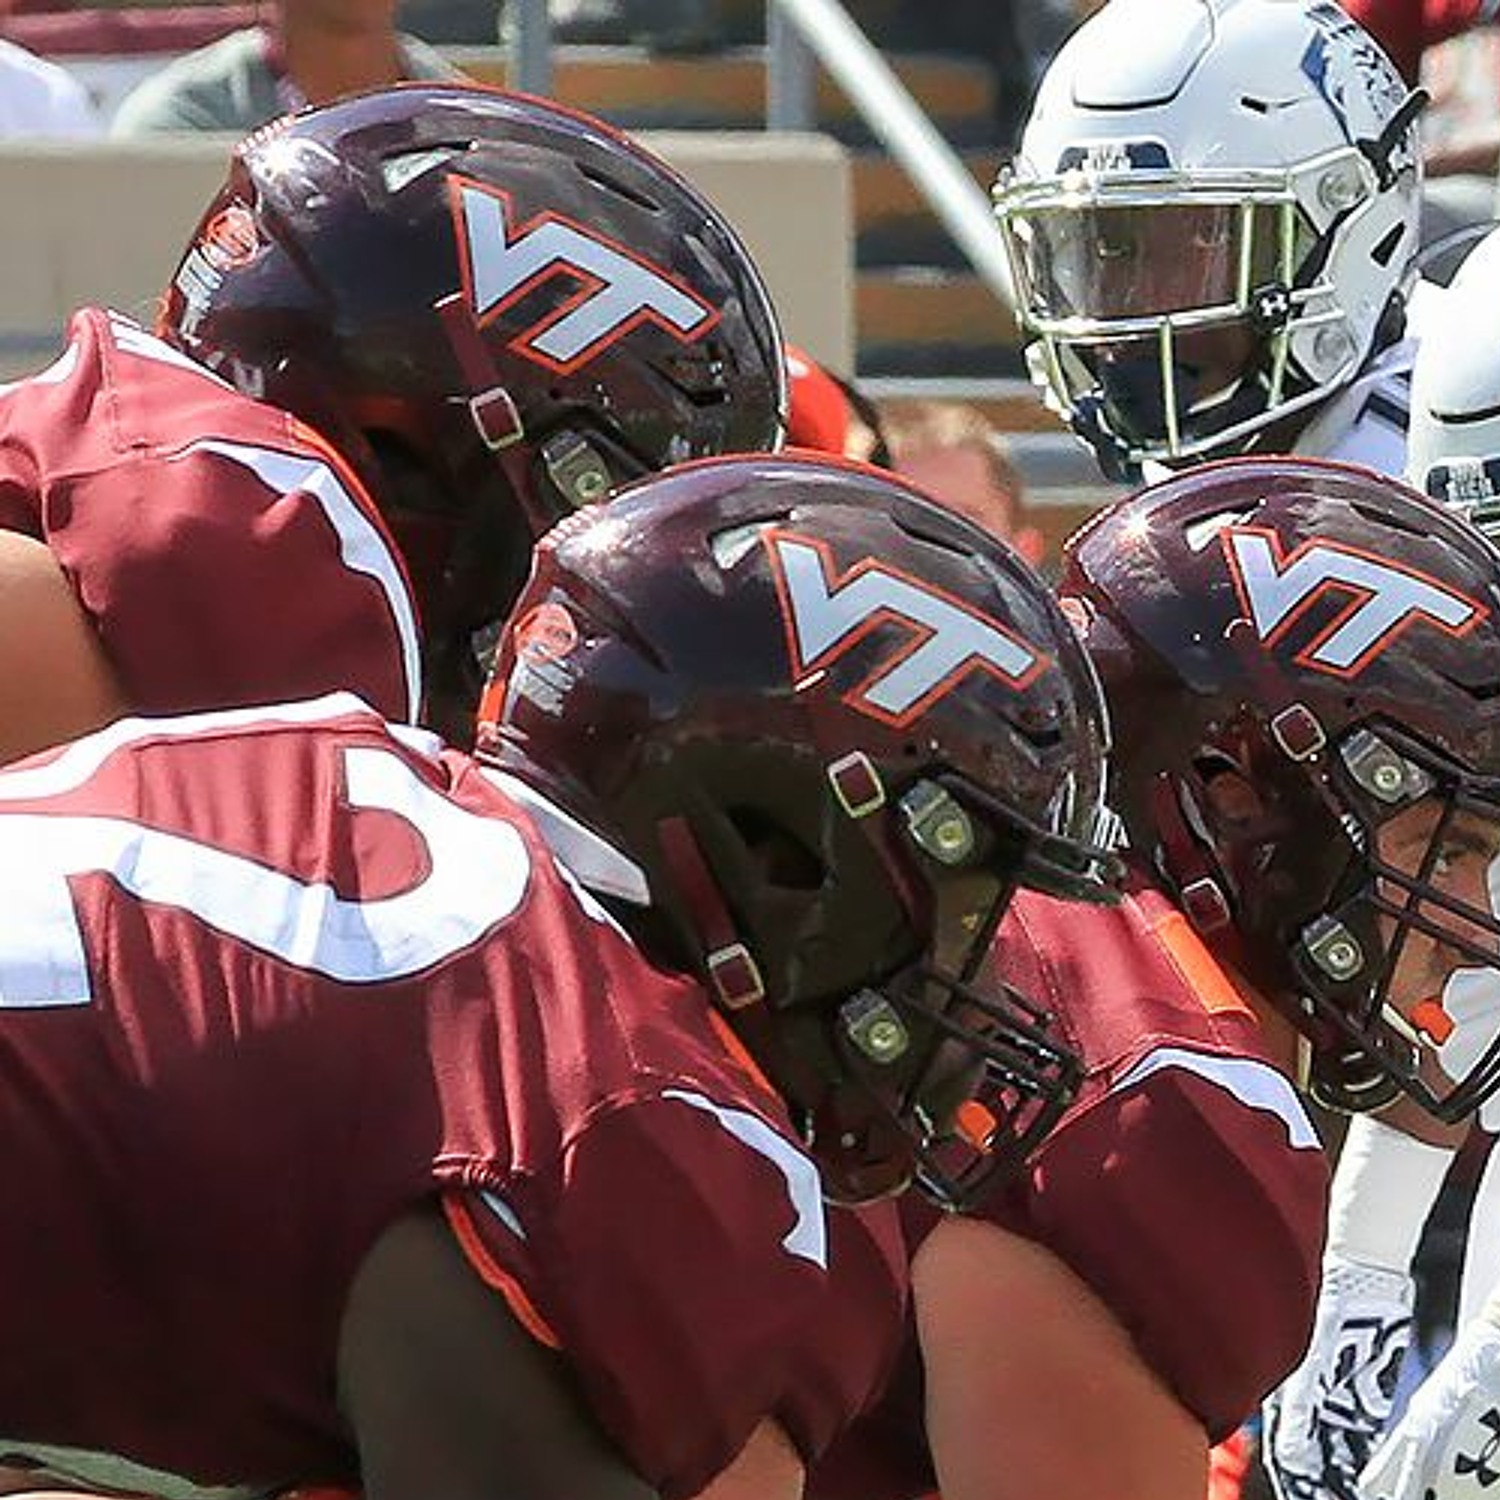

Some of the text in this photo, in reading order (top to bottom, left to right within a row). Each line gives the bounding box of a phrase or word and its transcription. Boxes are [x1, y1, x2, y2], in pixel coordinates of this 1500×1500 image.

[446, 174, 721, 376] VT
[767, 528, 1051, 728] VT
[1221, 527, 1490, 678] VT
[0, 692, 533, 1008] 2
